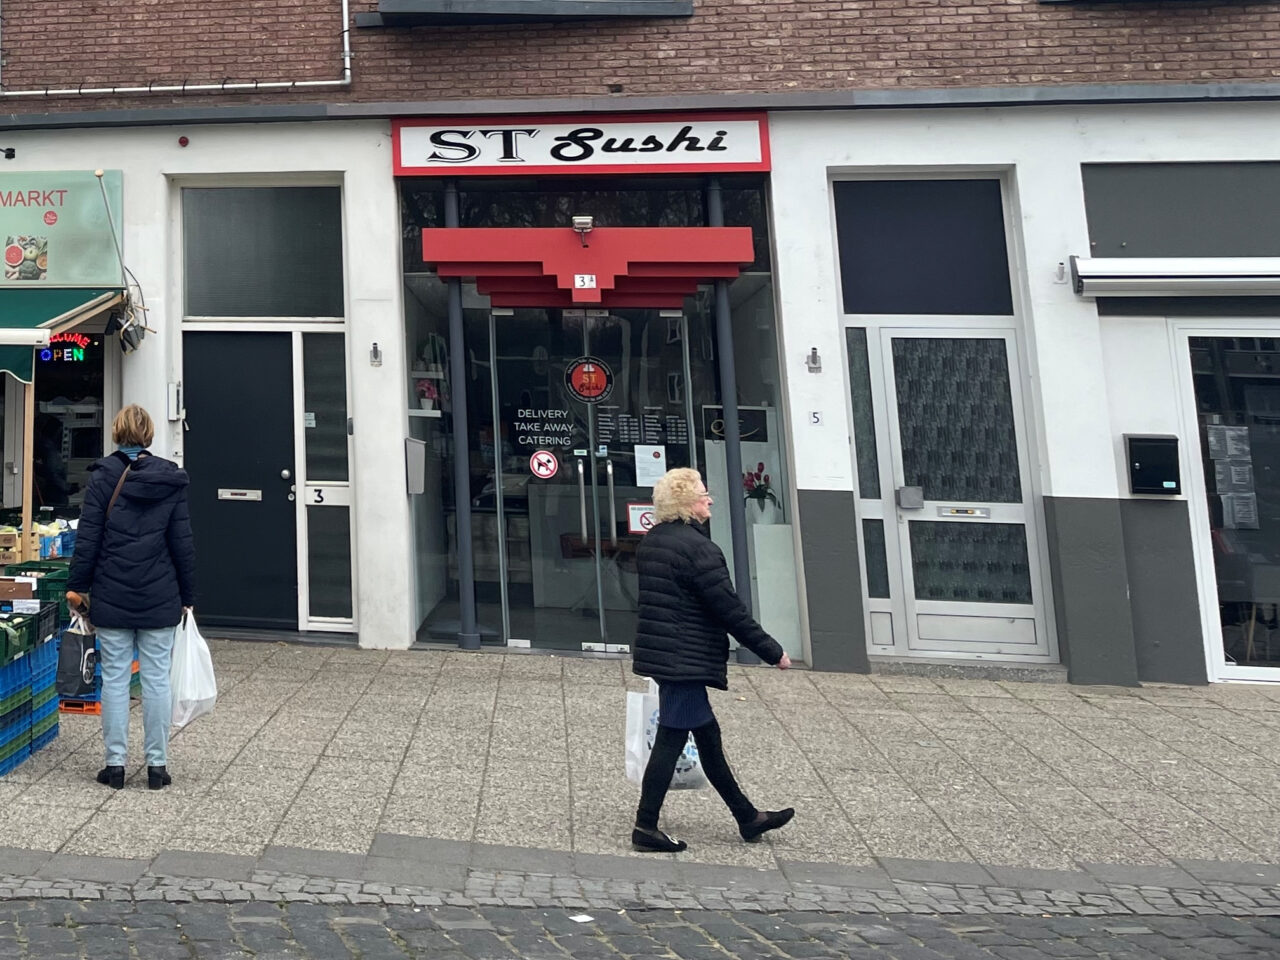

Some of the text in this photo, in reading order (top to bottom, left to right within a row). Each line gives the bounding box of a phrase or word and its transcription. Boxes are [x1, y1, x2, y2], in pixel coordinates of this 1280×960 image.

[427, 126, 728, 163] ST Sushi
[579, 276, 586, 287] 3
[41, 348, 84, 361] OPEN
[582, 373, 597, 384] ST
[517, 409, 568, 419] DELIVERY
[812, 411, 820, 424] 5
[513, 422, 574, 432] TAKE AWAY
[518, 435, 571, 446] CATERING
[314, 489, 324, 503] 3
